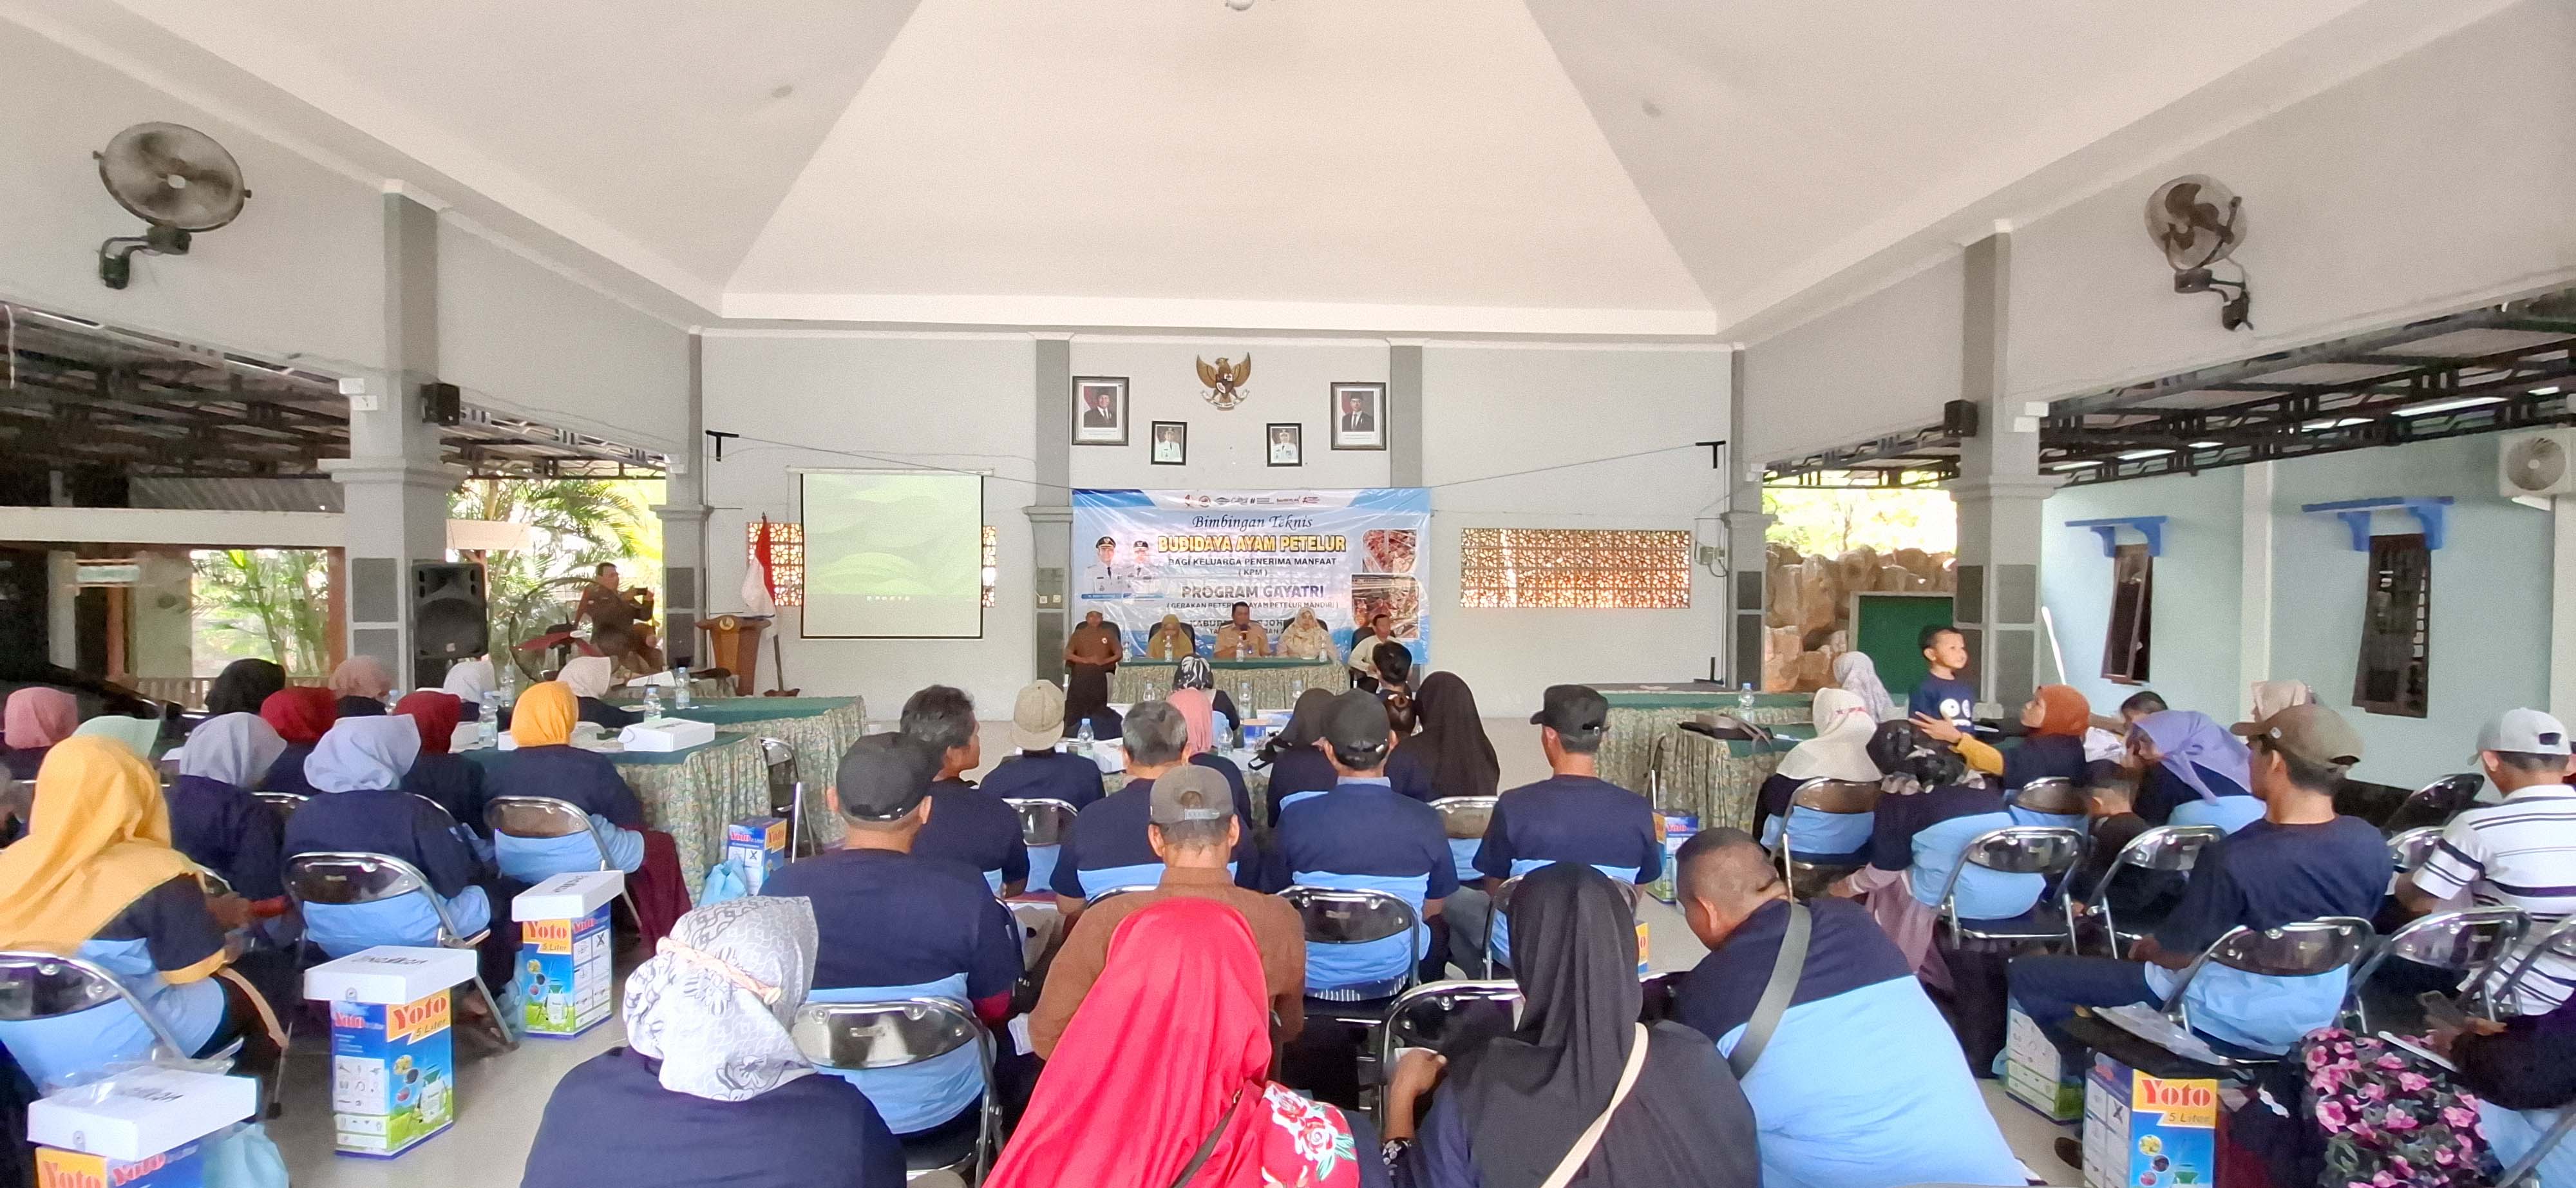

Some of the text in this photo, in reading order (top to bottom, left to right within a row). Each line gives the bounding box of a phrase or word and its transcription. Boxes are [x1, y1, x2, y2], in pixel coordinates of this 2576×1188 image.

[1191, 514, 1313, 532] Bimbingan Teknis
[1157, 535, 1347, 553] BUDIDAYA AYAM PETELUR
[1169, 557, 1191, 566] BAGI
[1182, 585, 1325, 598] PROGRAM GAYATRI
[525, 921, 567, 939] Yoto
[393, 997, 447, 1031] Yoto
[415, 1018, 446, 1037] 5 Liter
[2141, 1079, 2211, 1106] Yoto
[2168, 1113, 2175, 1122] 5
